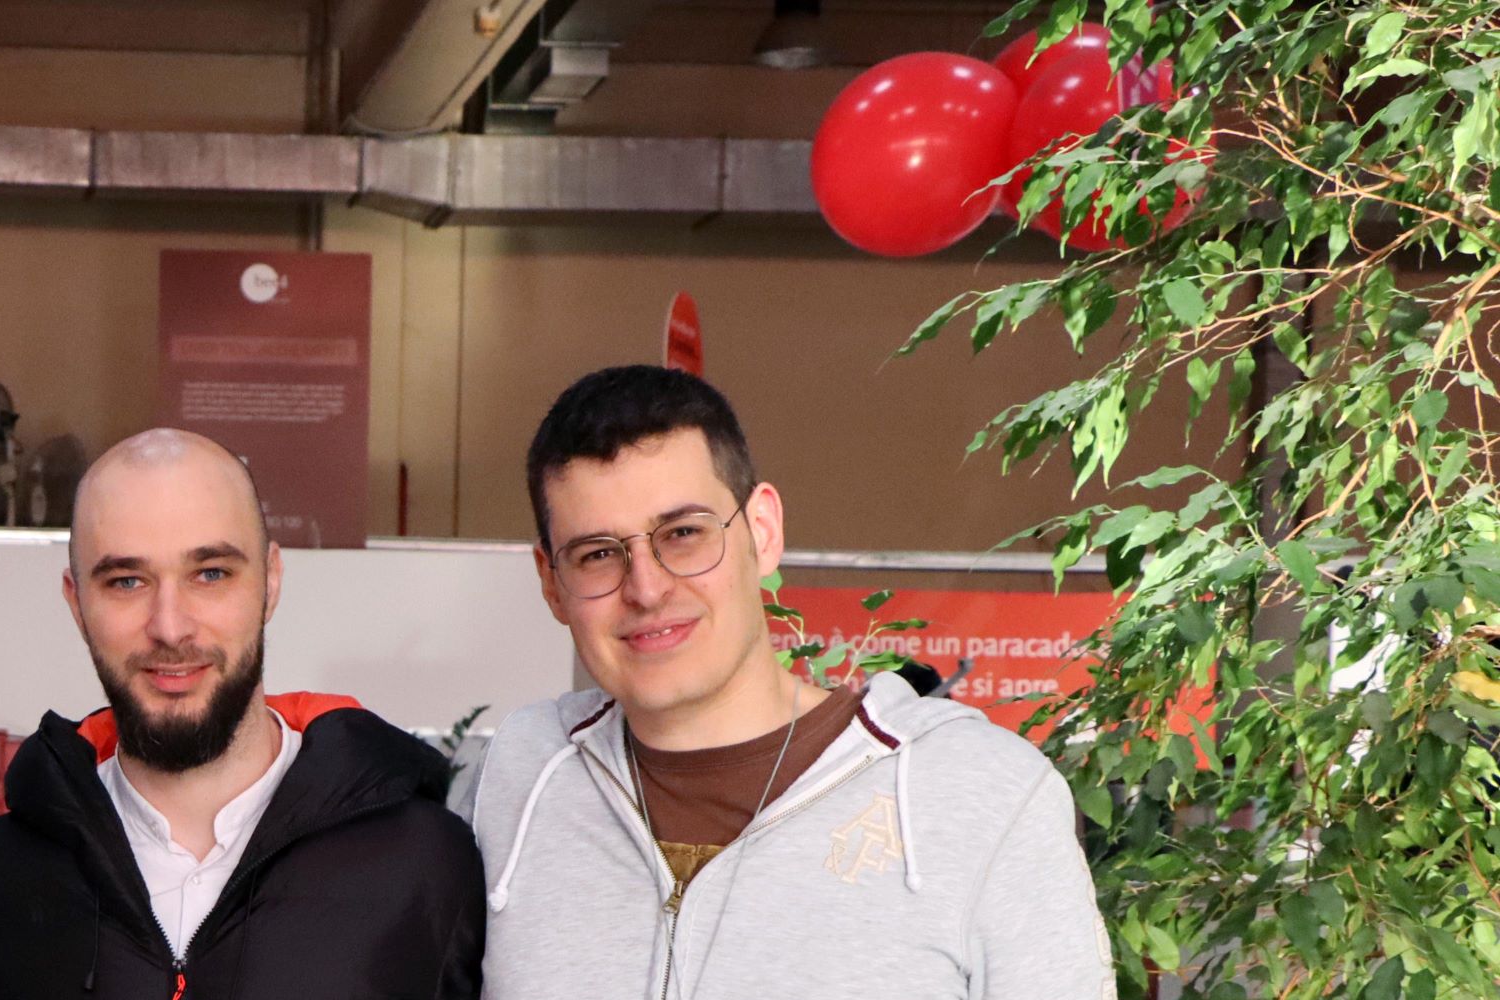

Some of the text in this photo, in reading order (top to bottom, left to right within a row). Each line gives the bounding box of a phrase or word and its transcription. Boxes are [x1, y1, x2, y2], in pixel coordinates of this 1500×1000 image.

[852, 633, 922, 655] come
[927, 636, 961, 655] un
[972, 671, 993, 698] si
